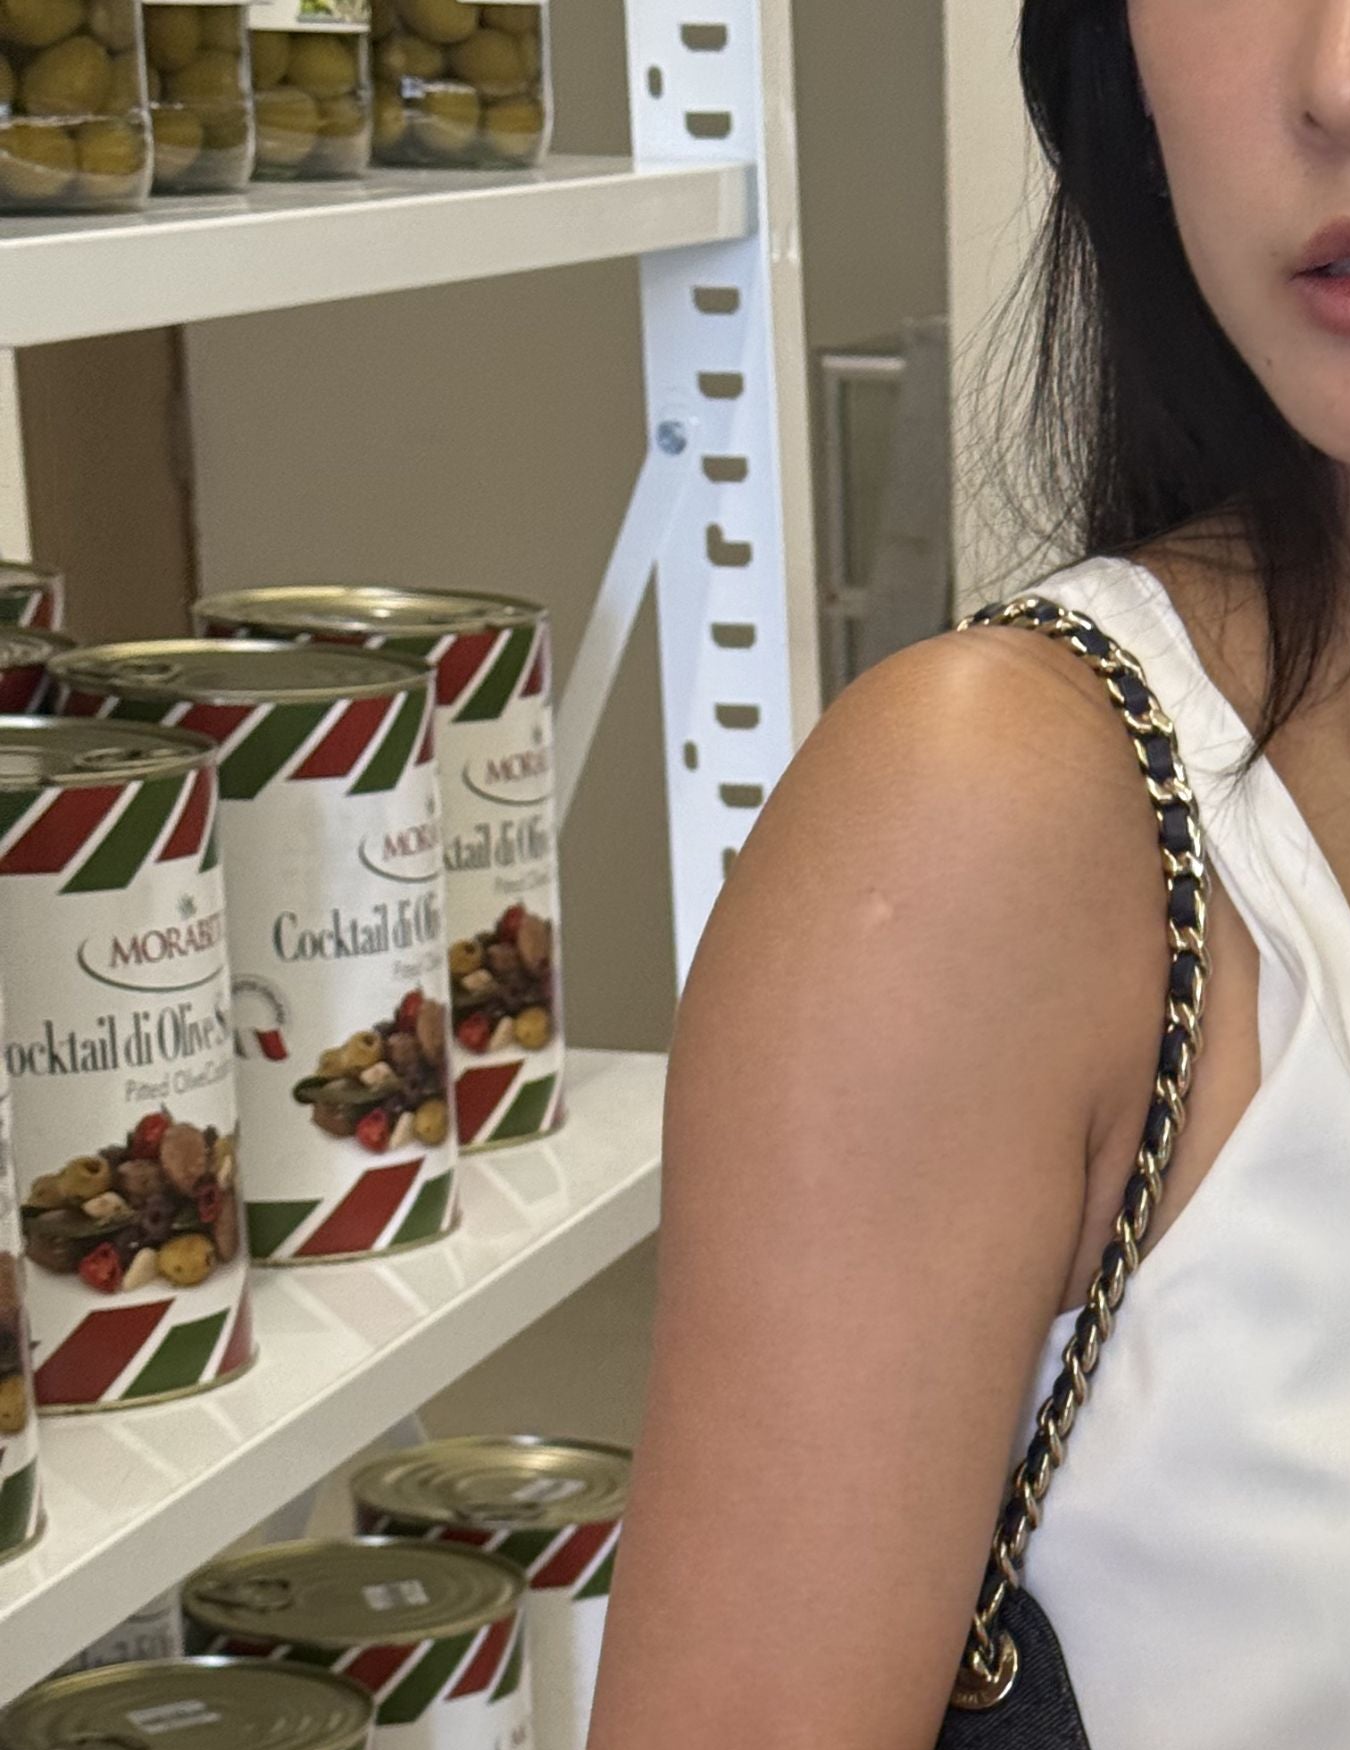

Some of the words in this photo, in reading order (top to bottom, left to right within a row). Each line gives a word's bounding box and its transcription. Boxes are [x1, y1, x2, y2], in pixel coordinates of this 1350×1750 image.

[273, 902, 389, 962] Cocktail
[5, 1014, 119, 1077] ocktail
[124, 1010, 152, 1067] di
